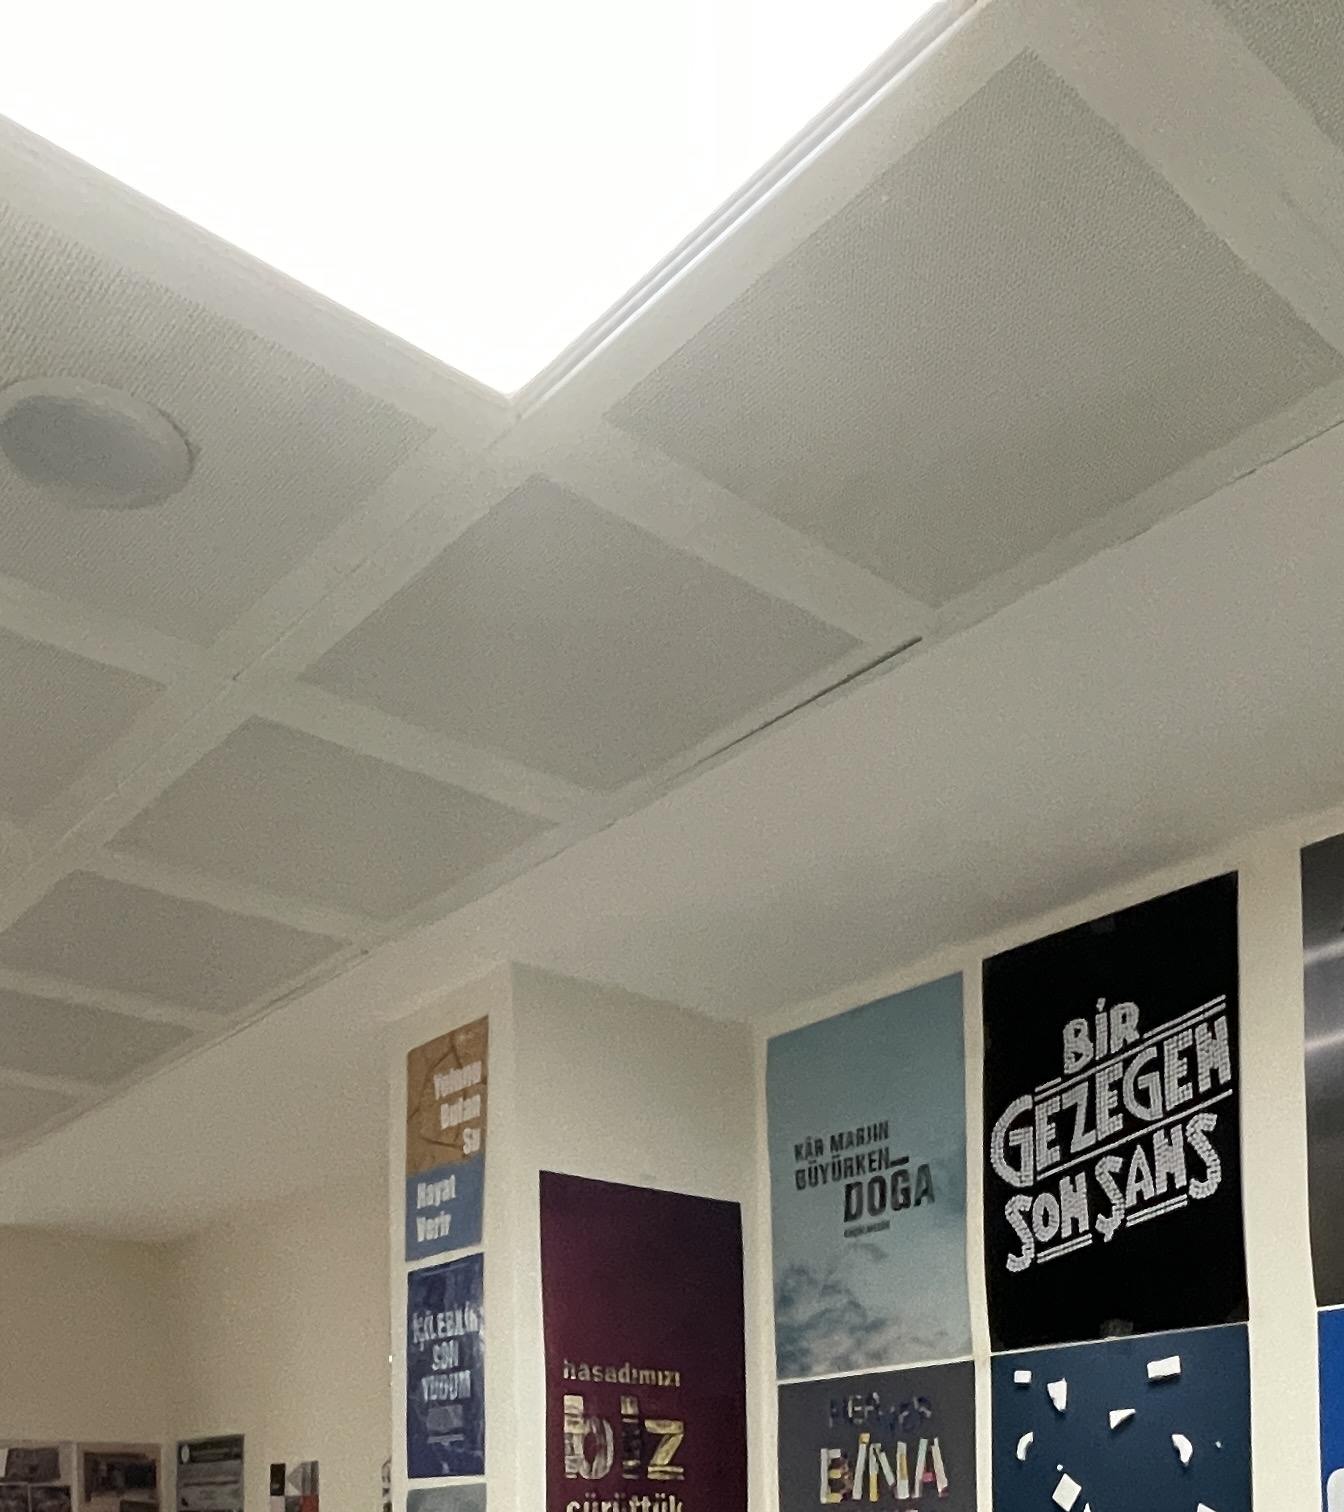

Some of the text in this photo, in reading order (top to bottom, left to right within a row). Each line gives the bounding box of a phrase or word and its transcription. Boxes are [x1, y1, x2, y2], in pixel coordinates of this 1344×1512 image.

[1062, 998, 1140, 1075] BİR
[990, 1014, 1232, 1188] GEZEGEN
[416, 1174, 456, 1210] Hayat
[795, 1147, 890, 1190] BÜYÜRKEN
[1005, 1112, 1218, 1273] SON ŞANS
[416, 1210, 452, 1243] Verir
[563, 1358, 681, 1387] hasadımızı
[563, 1395, 685, 1481] biz
[820, 1432, 948, 1504] BİNA
